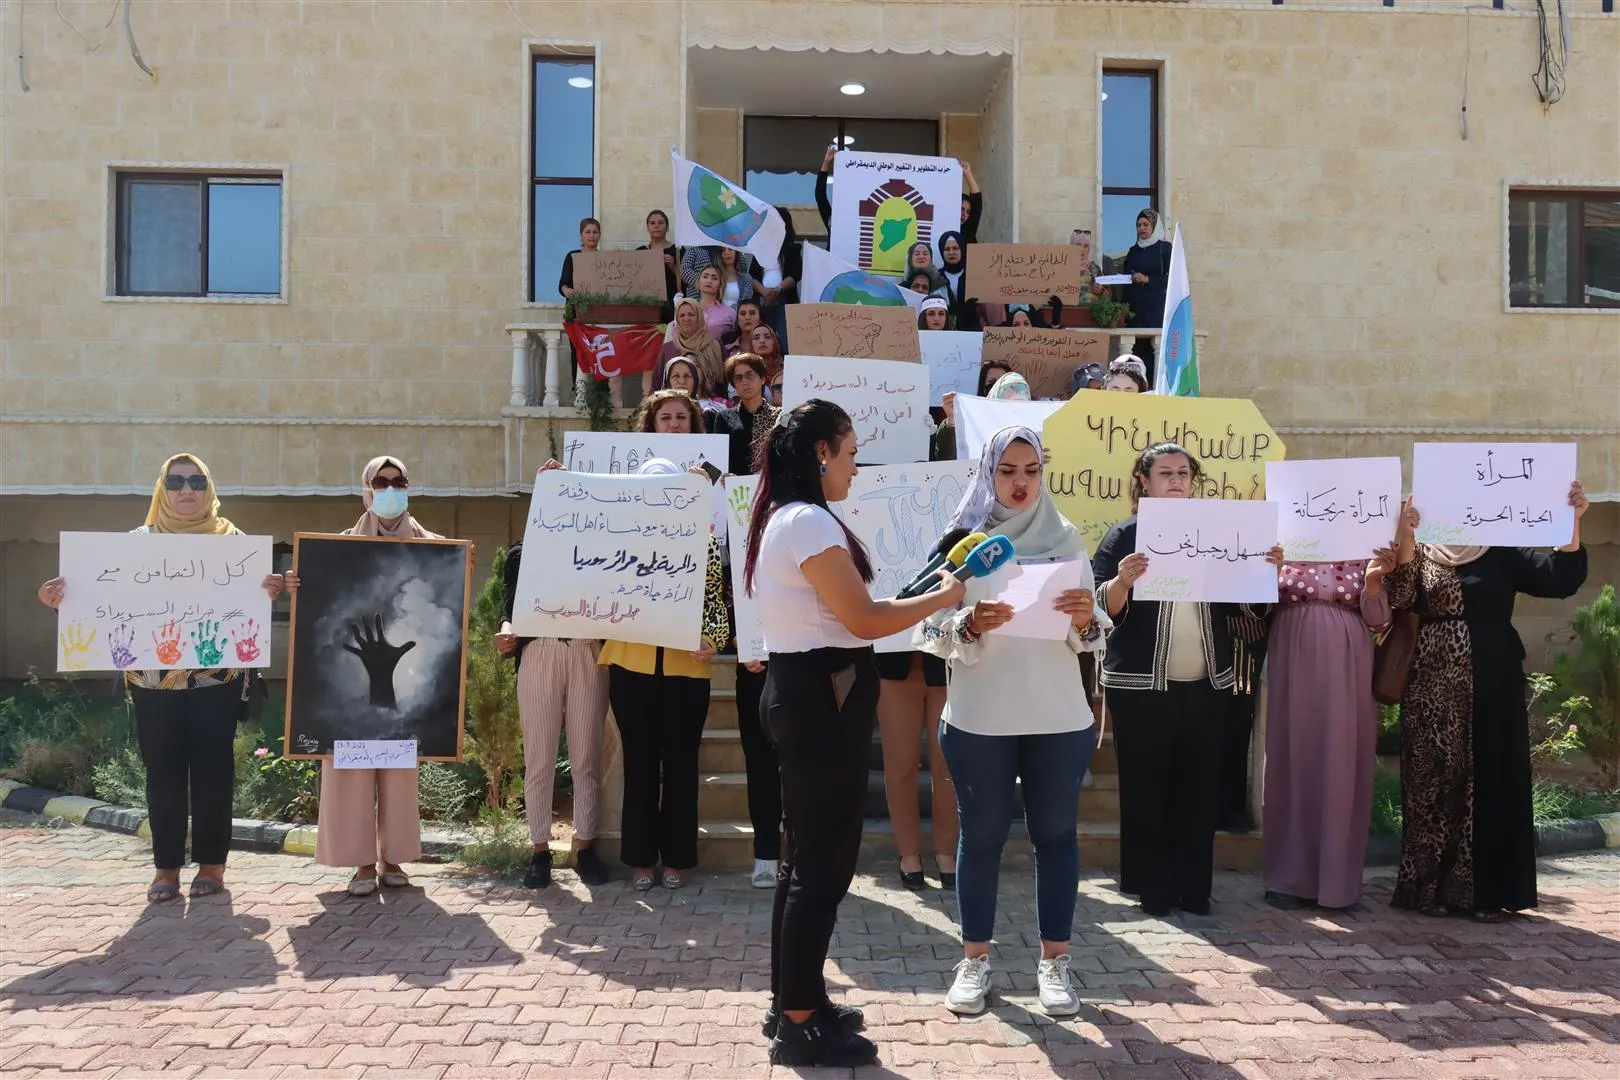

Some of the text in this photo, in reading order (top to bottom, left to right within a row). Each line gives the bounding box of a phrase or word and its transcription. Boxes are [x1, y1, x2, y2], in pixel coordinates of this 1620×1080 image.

[845, 159, 877, 169] الديمقراطي
[877, 161, 894, 172] الوطني
[895, 162, 912, 171] التغيير
[917, 163, 937, 173] التطوير
[938, 165, 951, 173] حزب
[1475, 449, 1534, 487] المرأة
[1350, 489, 1388, 524] المرأة
[1463, 505, 1552, 528] الحياة الحرية
[641, 525, 658, 537] مع
[573, 545, 608, 571] سوريا
[983, 541, 1004, 564] R
[96, 550, 259, 586] كل التضامن مع
[657, 553, 697, 578] والحرية
[663, 582, 694, 603] المرأة
